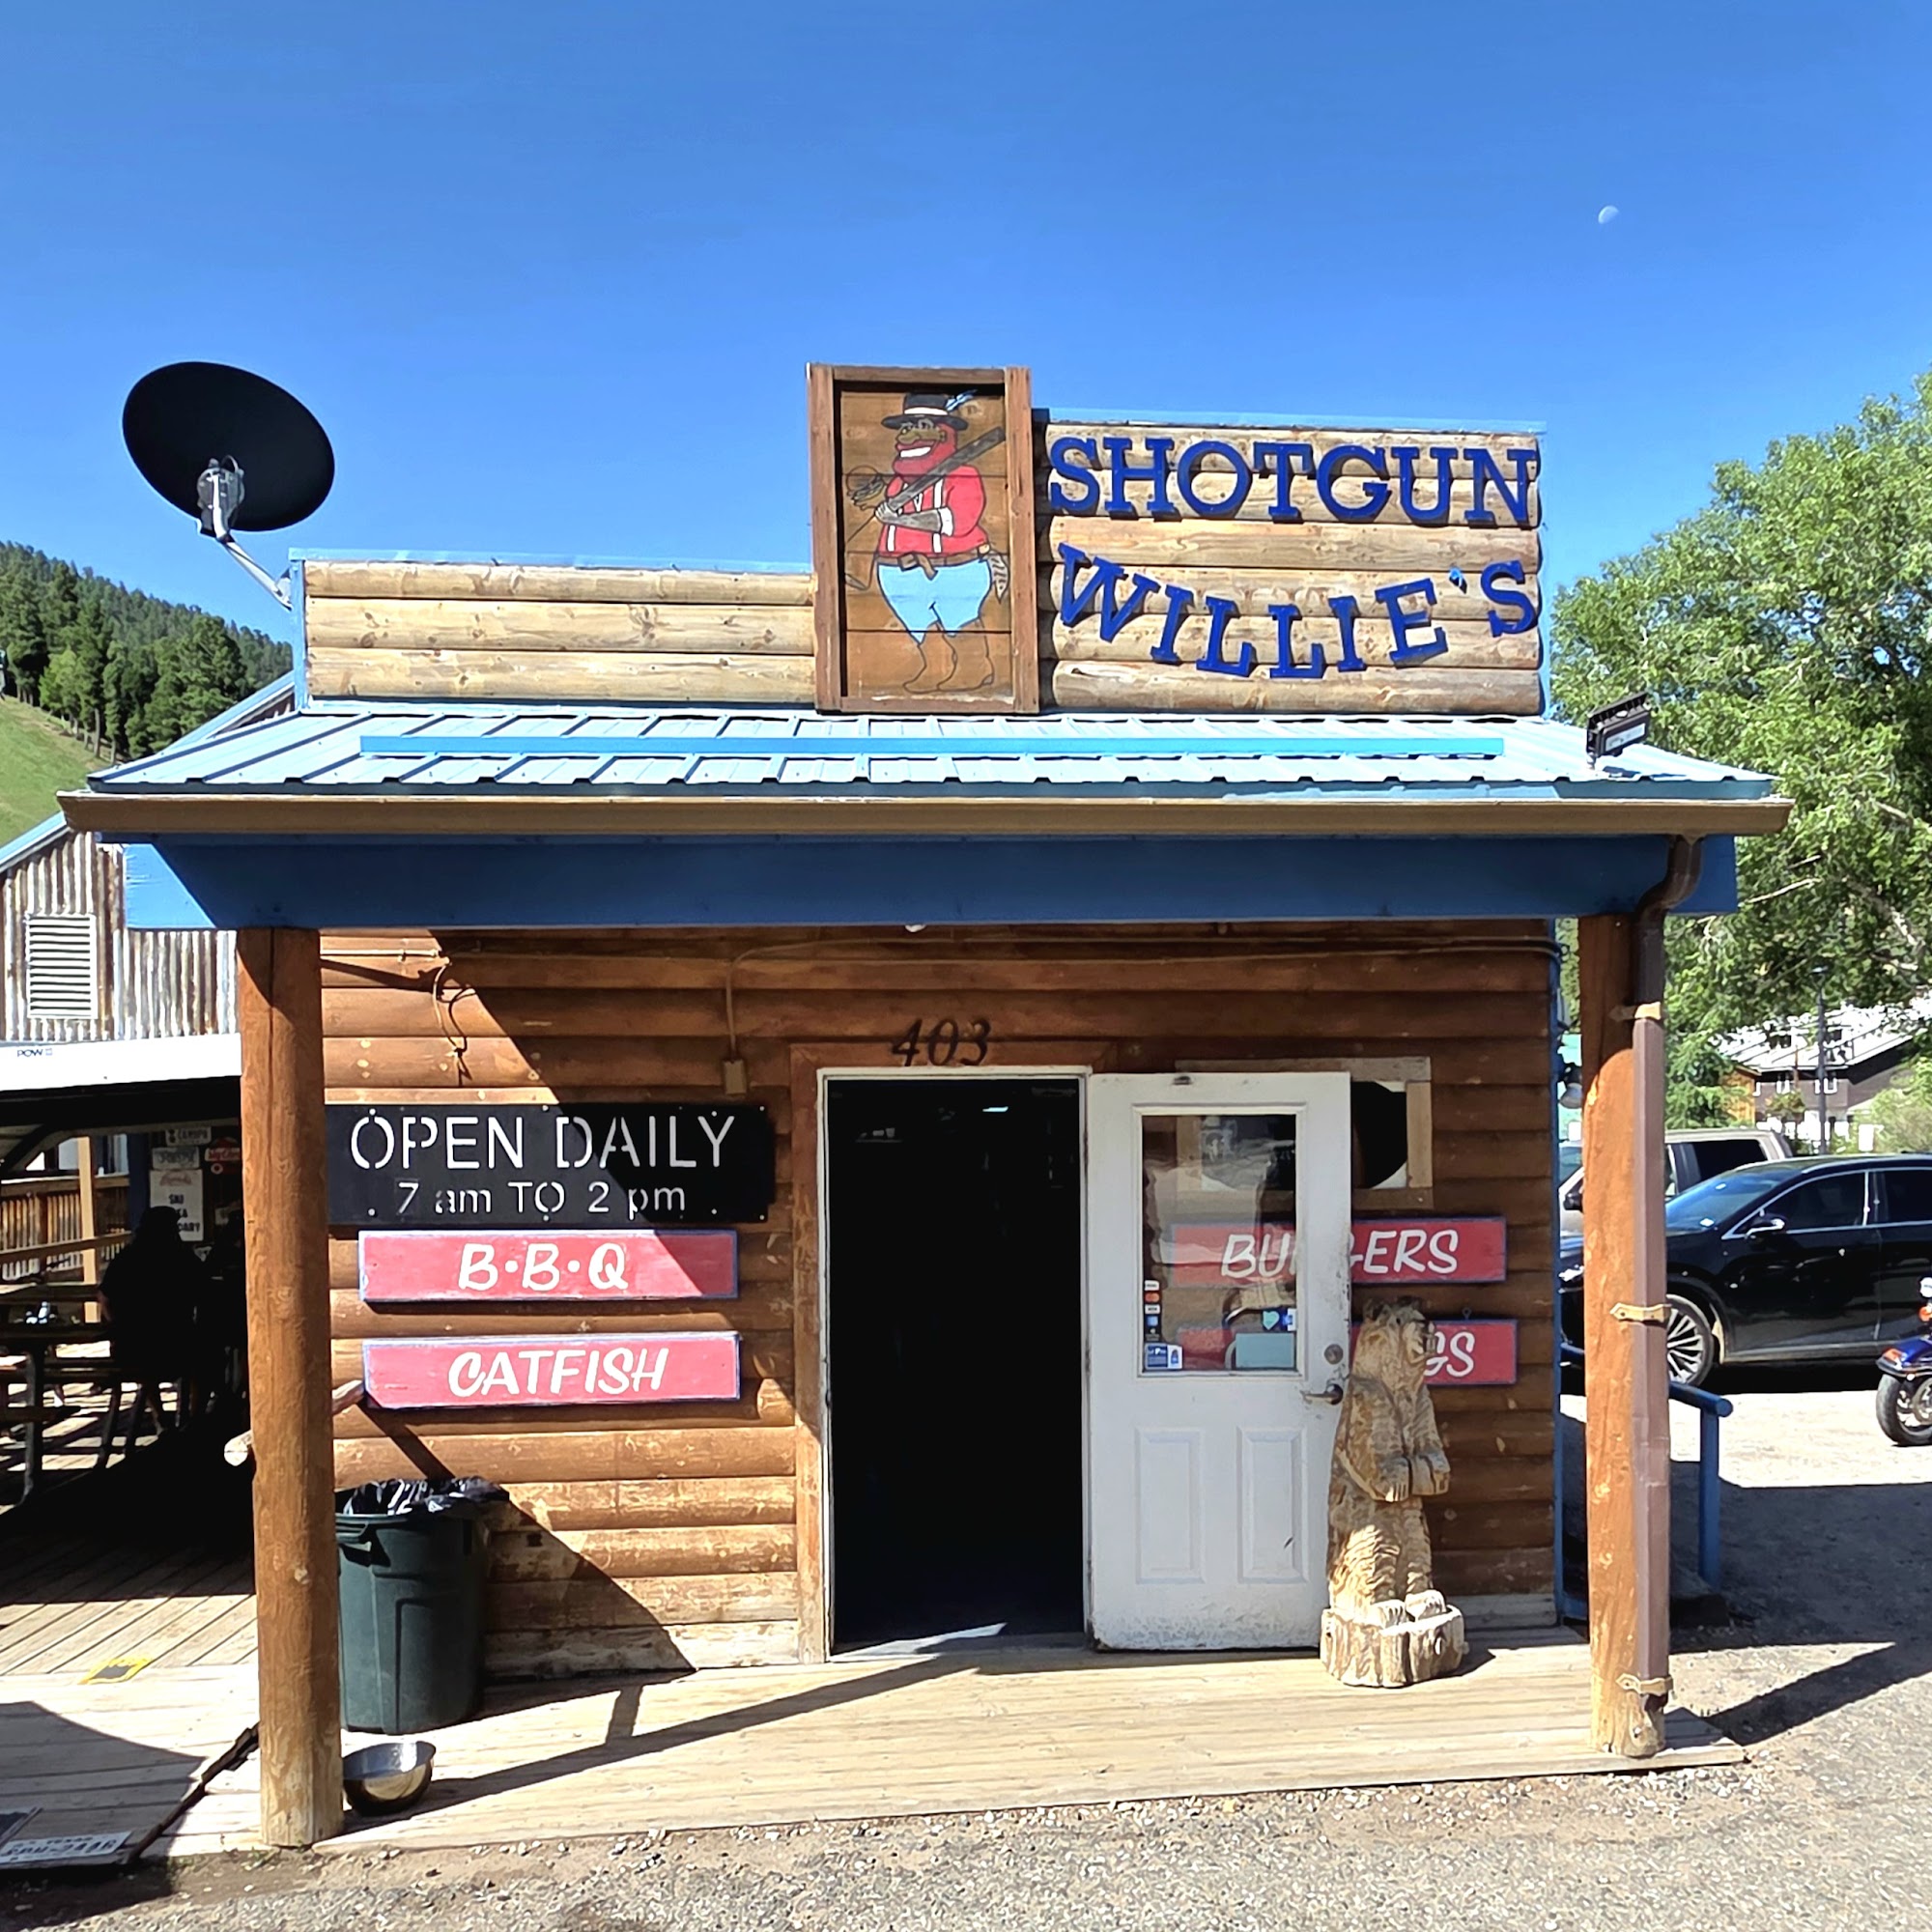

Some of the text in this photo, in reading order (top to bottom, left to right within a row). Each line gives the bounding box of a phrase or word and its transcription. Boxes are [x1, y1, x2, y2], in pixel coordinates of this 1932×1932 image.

[1049, 435, 1539, 528] SHOTGUN
[1057, 542, 1539, 679] WILLIE'S
[891, 1017, 992, 1067] 403
[351, 1115, 735, 1170] OPEN DAILY
[398, 1180, 687, 1220] 7 am TO 2 pm
[1220, 1228, 1460, 1280] BUERS
[447, 1347, 670, 1398] CATFISH
